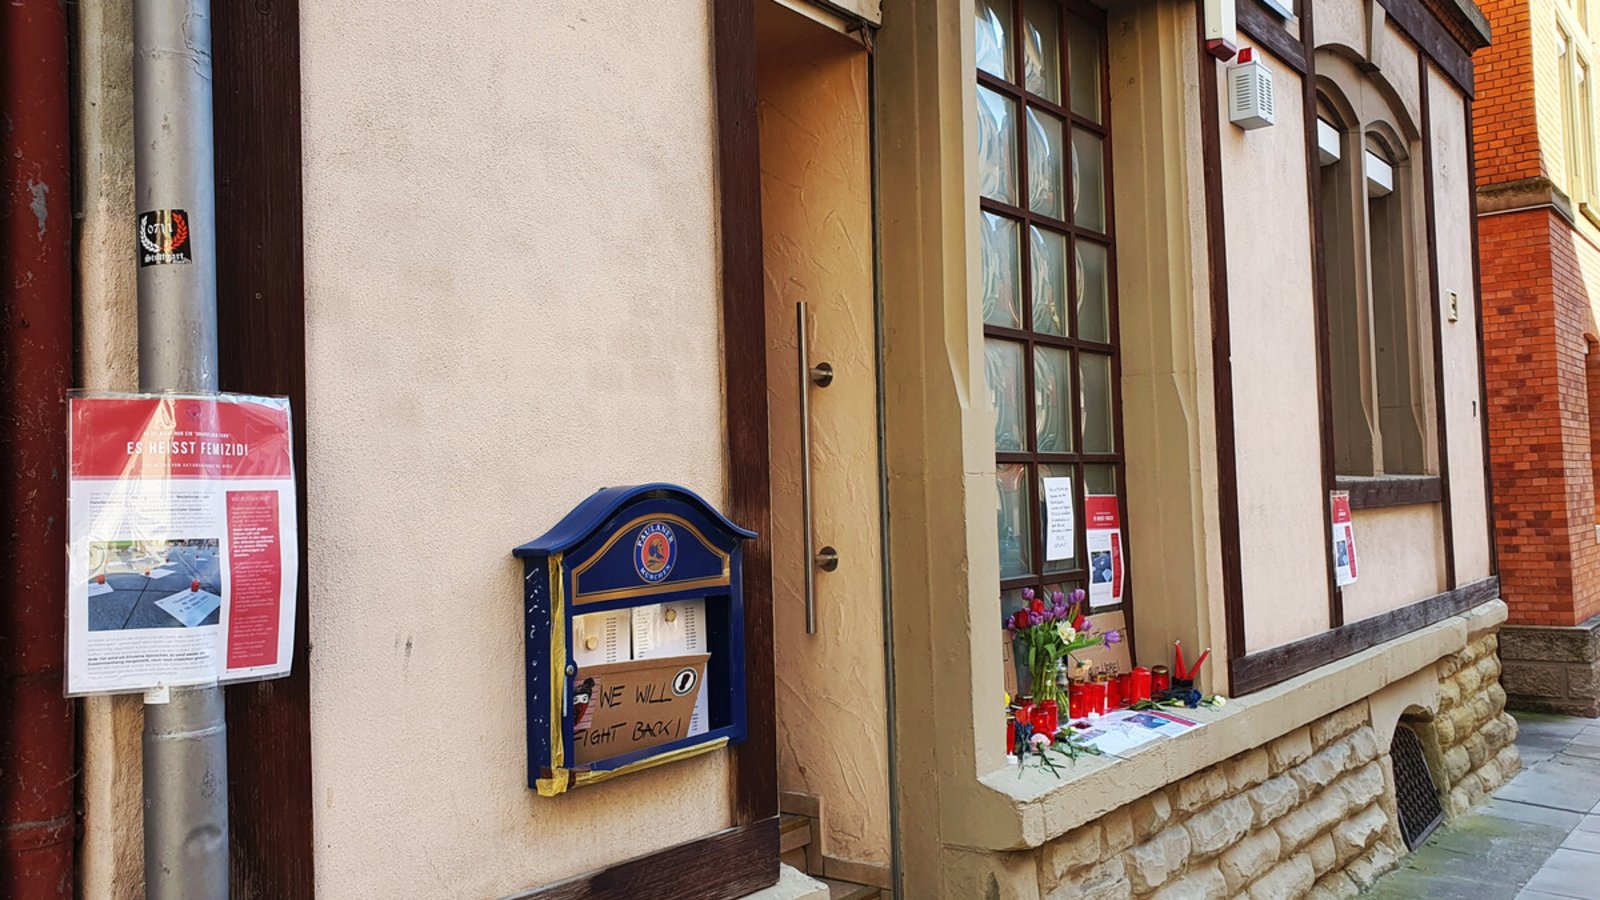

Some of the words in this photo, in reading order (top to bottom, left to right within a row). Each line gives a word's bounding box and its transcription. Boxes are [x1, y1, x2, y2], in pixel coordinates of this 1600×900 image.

[127, 441, 143, 455] ES
[149, 441, 196, 455] HEISST
[201, 442, 249, 456] FEMIZID!
[637, 524, 674, 547] PAULANER
[600, 683, 625, 709] WE
[635, 683, 672, 704] WILL
[574, 722, 627, 747] FIGHT
